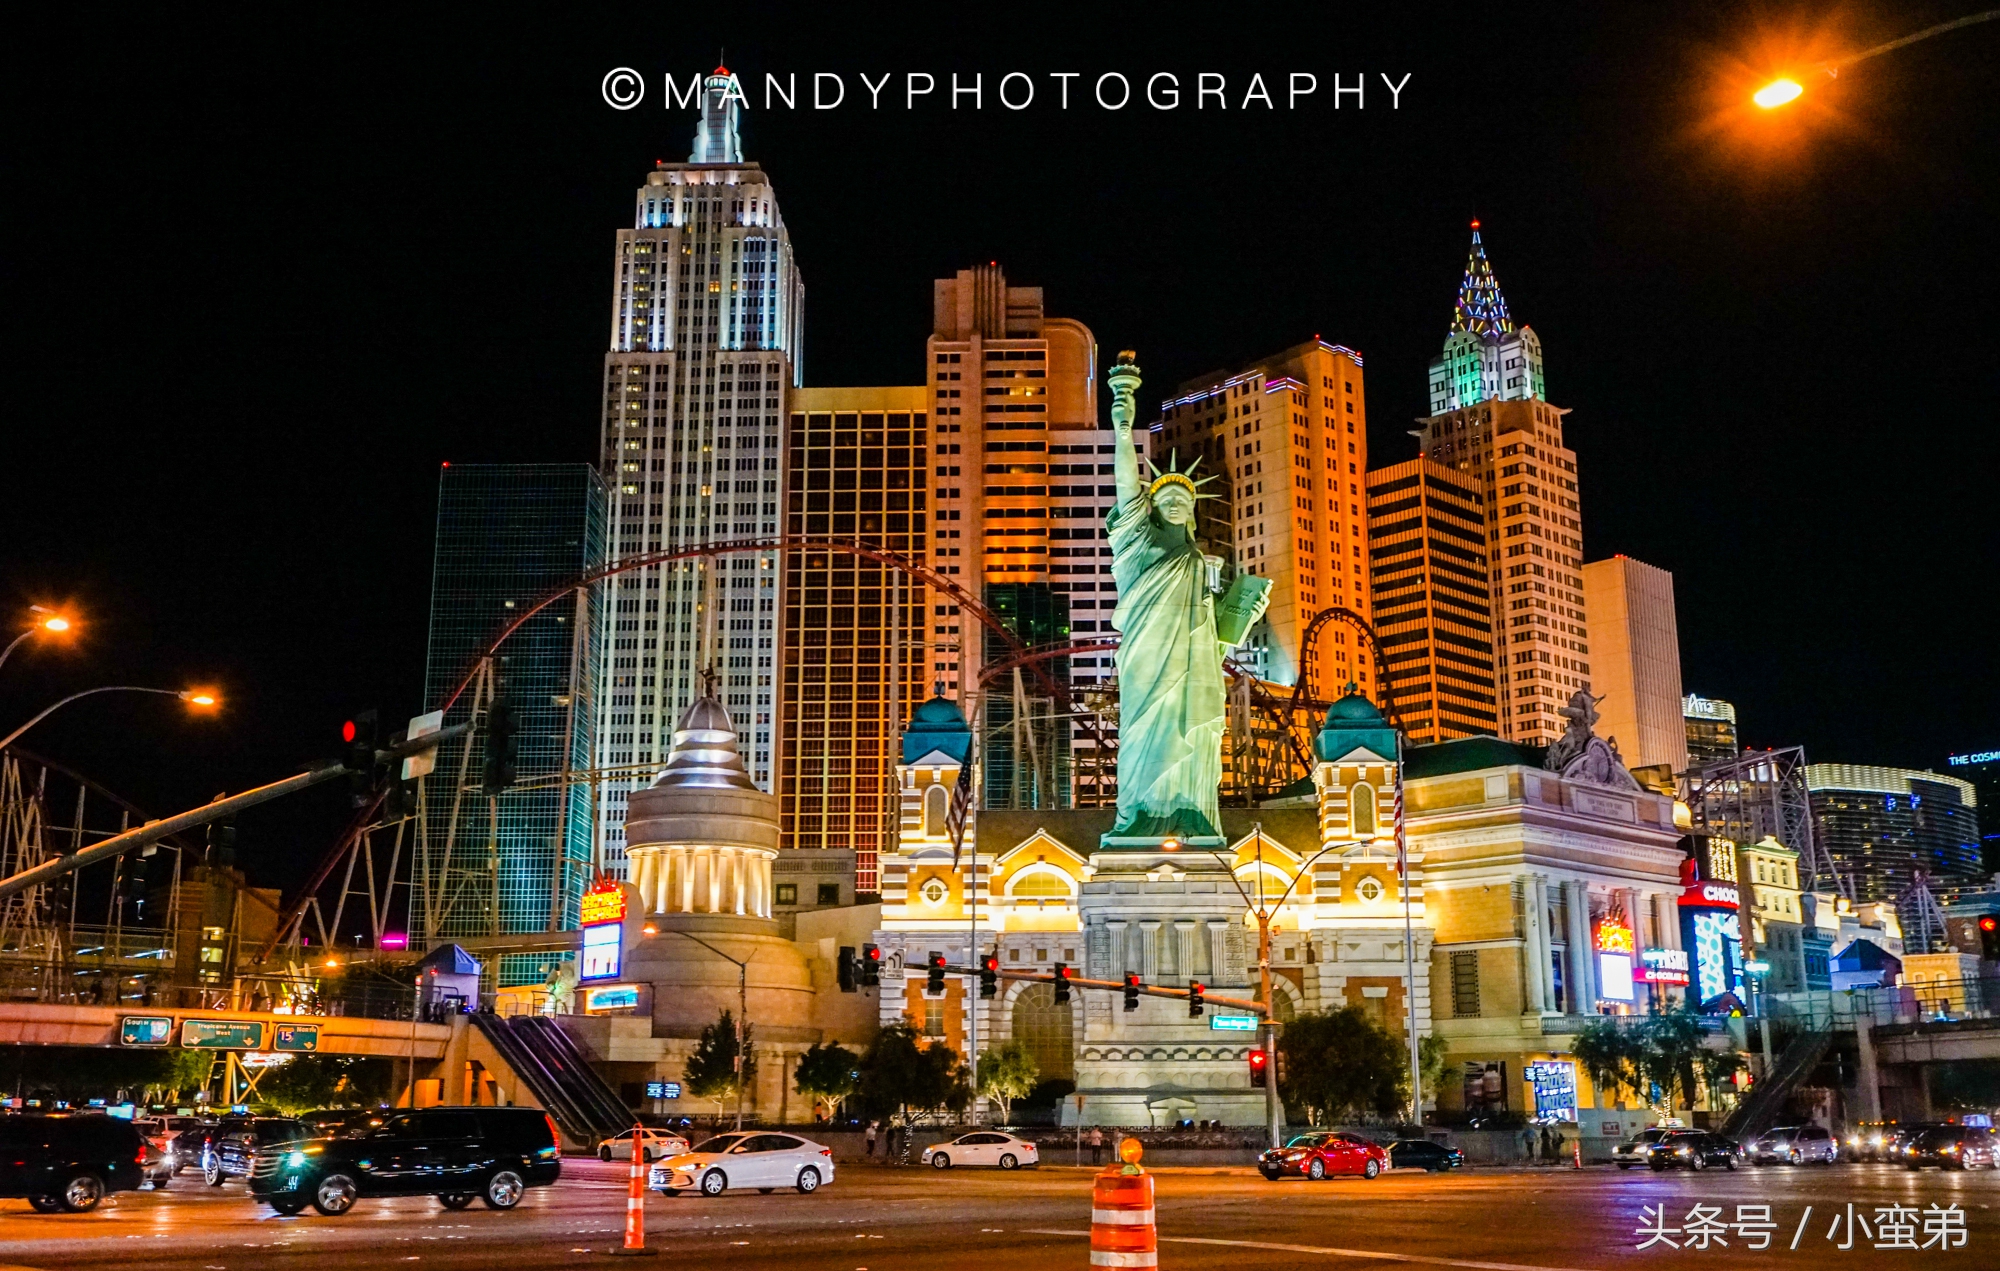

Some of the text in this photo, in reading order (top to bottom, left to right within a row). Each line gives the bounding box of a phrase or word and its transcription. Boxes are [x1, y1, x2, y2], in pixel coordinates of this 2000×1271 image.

[1687, 693, 1714, 714] Aria
[1948, 751, 2000, 765] THE COSM
[281, 1031, 294, 1041] 15
